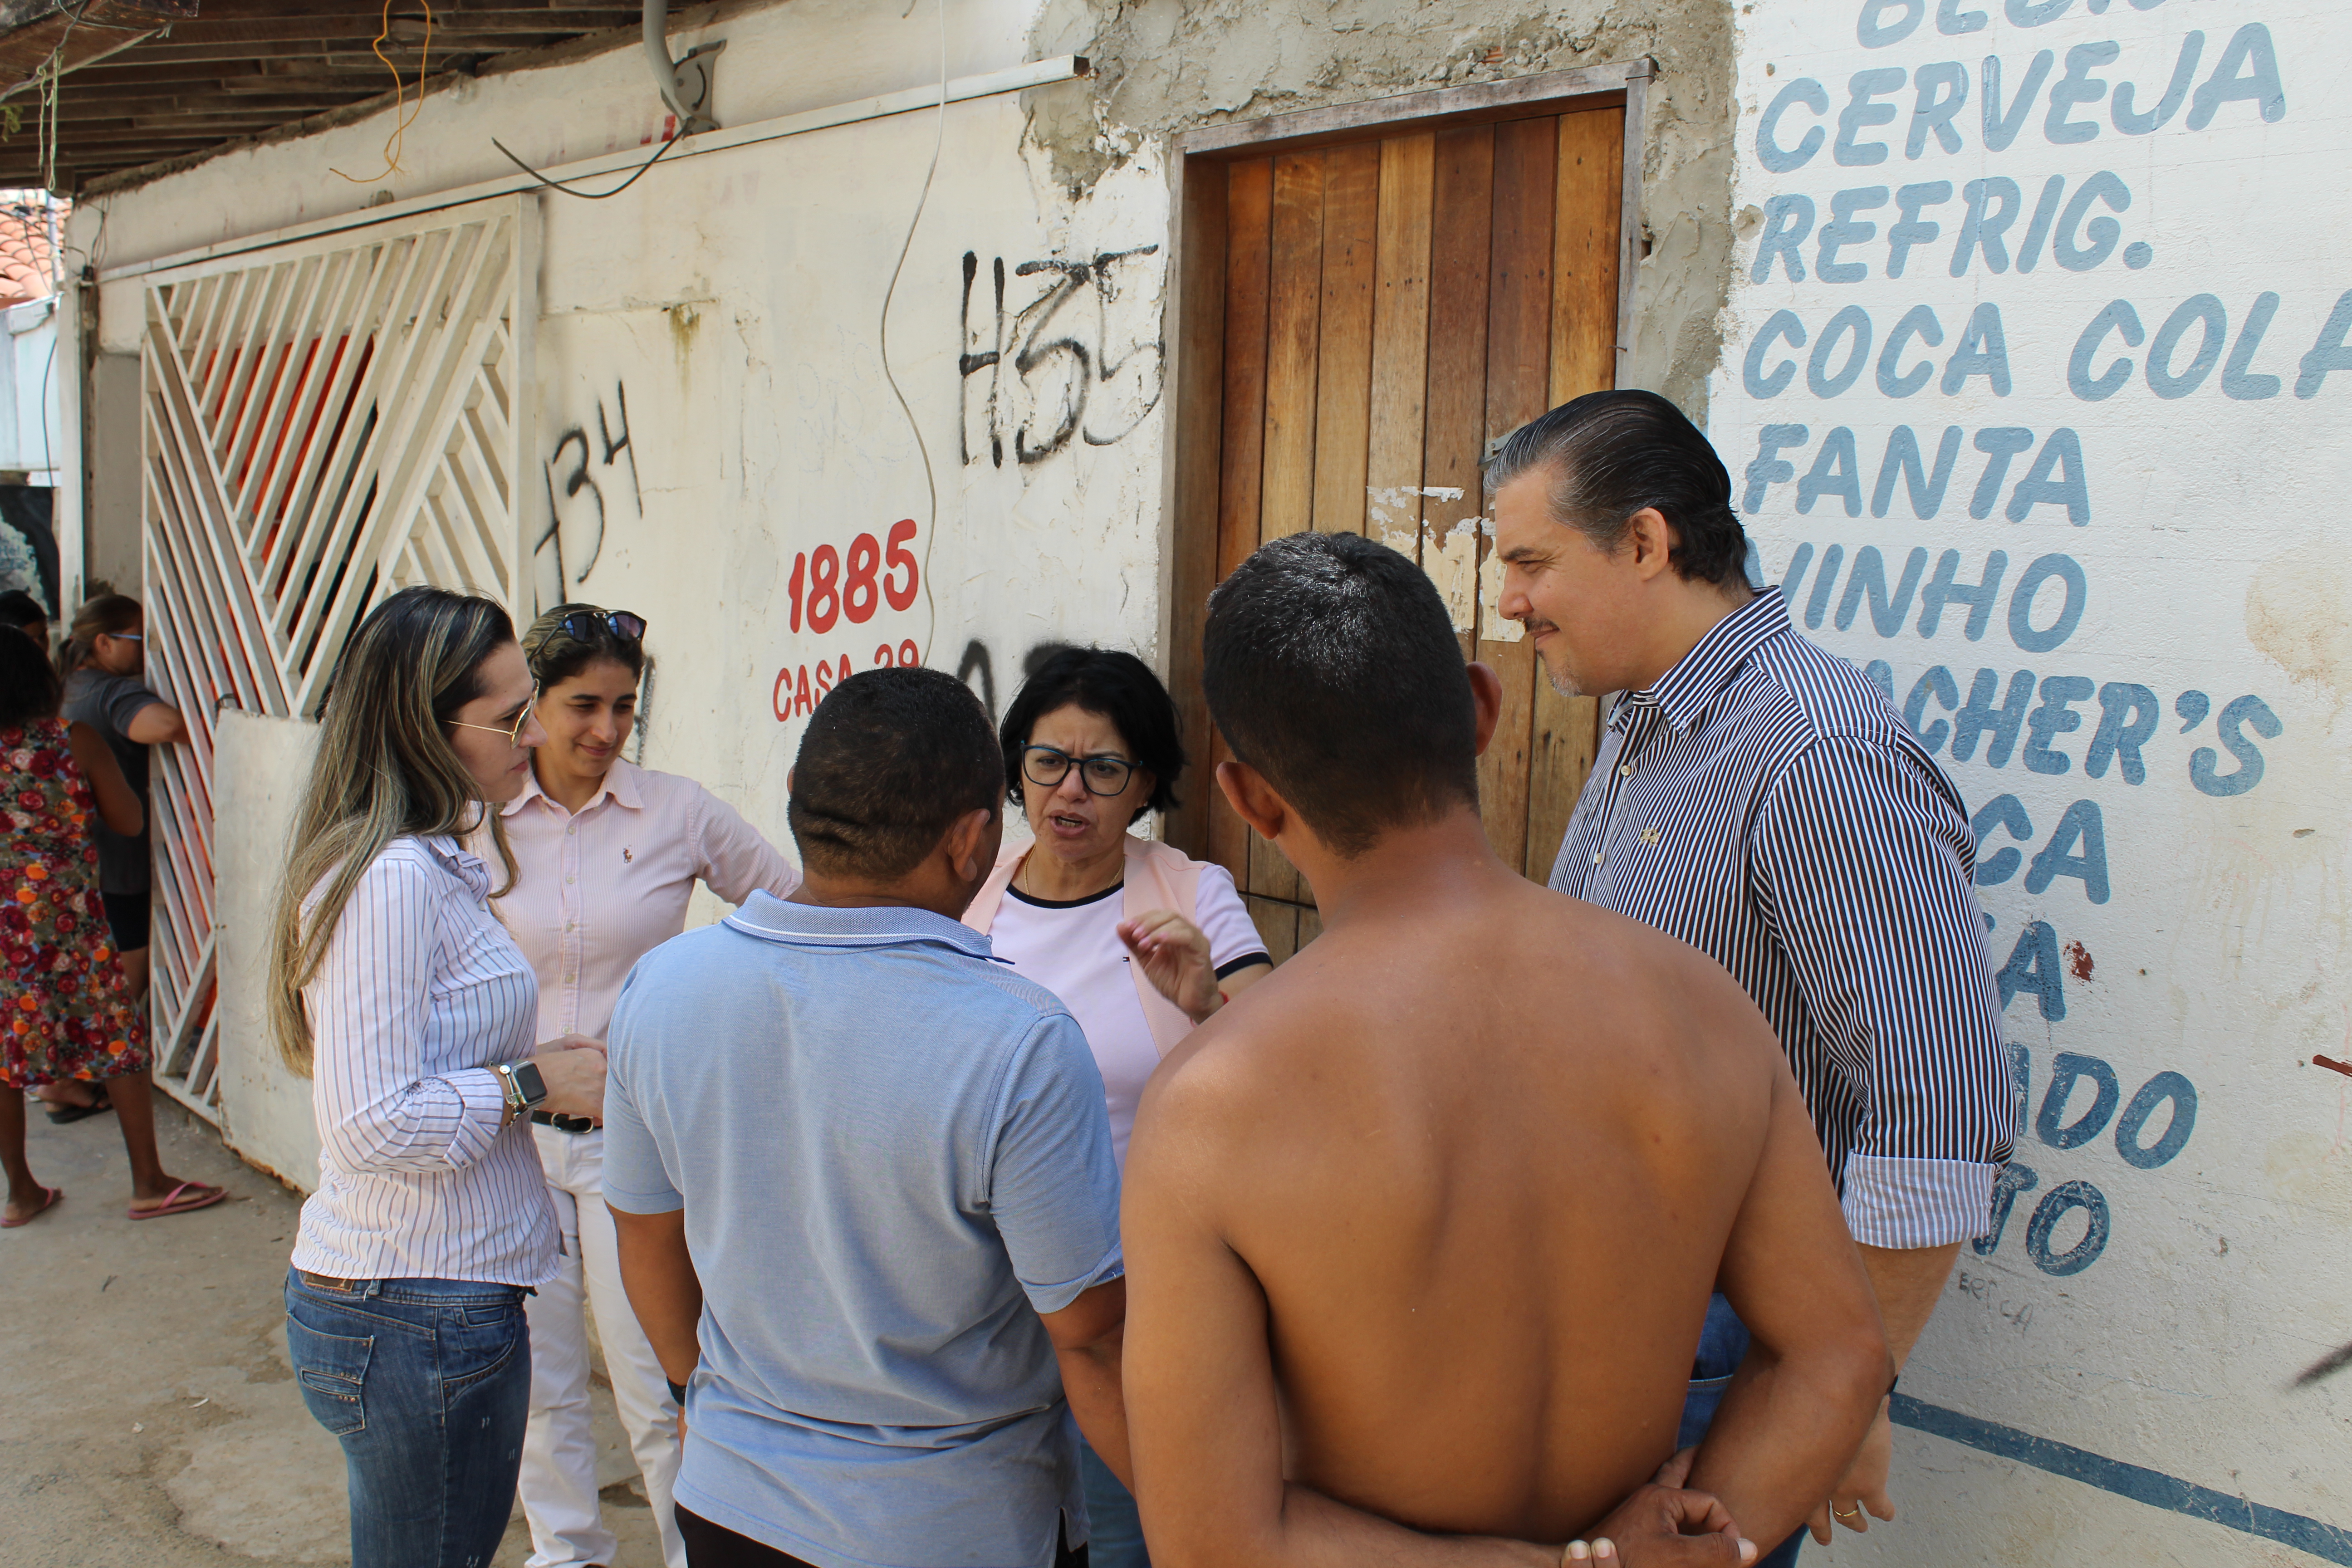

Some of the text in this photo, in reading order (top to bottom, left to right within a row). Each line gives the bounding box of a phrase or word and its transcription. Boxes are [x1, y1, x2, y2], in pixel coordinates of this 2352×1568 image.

[1755, 22, 2287, 173] CERVEJA
[1750, 170, 2154, 285] REFRIG.
[1742, 287, 2352, 402] COCA COLA
[1743, 423, 2092, 527] FANTA
[788, 519, 919, 634] 1885
